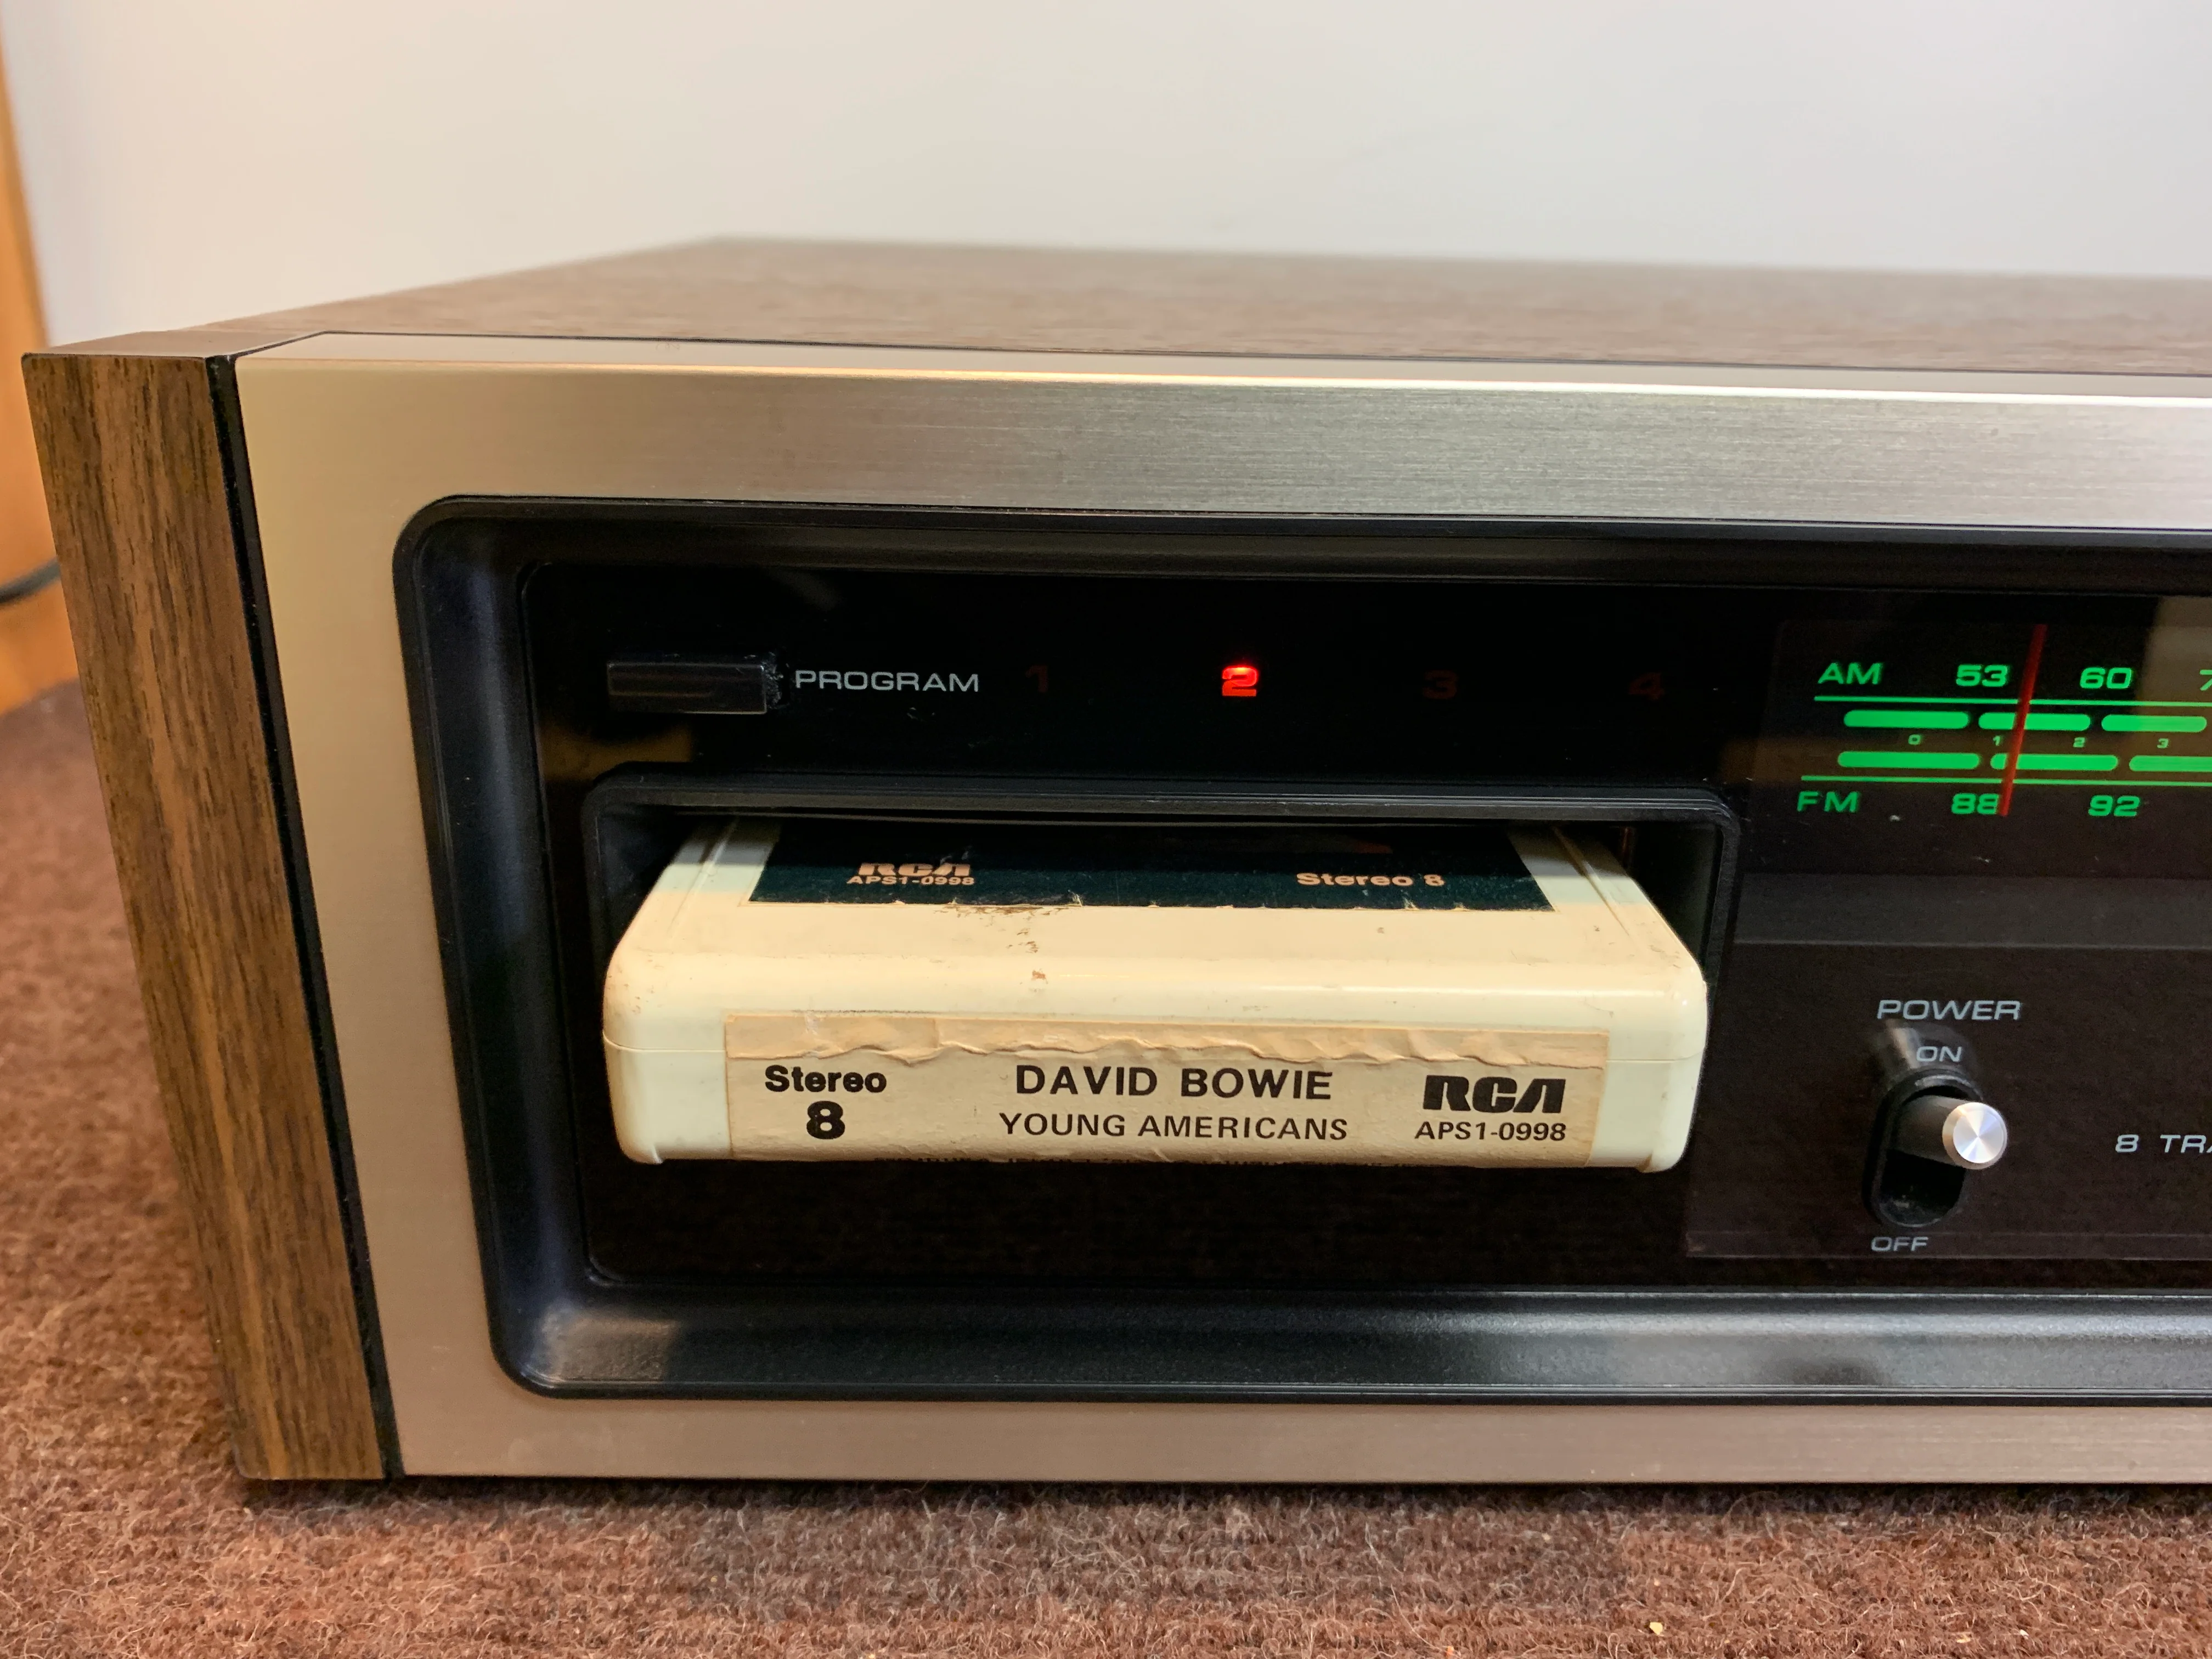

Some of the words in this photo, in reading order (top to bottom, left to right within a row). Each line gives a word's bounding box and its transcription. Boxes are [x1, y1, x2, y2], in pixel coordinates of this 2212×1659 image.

[795, 670, 980, 692] PROGRAM
[1025, 664, 1049, 693] 1
[1221, 664, 1259, 697] 2
[1422, 669, 1458, 700] 3
[1628, 672, 1665, 701] 4
[1818, 662, 1882, 685] AM
[1955, 665, 2008, 687] 53
[2079, 667, 2133, 689] 60
[1993, 735, 2001, 746] 1
[2072, 737, 2086, 748] 2
[2157, 738, 2169, 749] 3
[1797, 791, 1859, 812] FM
[1951, 793, 2000, 815] 88
[2088, 795, 2141, 817] 92
[859, 862, 971, 876] RCA
[1296, 872, 1413, 886] Stereo
[1424, 874, 1445, 886] 8
[847, 876, 975, 885] APS1-0998
[1877, 999, 2023, 1021] POWER
[1916, 1046, 1963, 1063] ON
[765, 1065, 887, 1093] Stereo
[1016, 1065, 1158, 1096] DAVID
[1181, 1068, 1333, 1100] BOWIE
[1423, 1074, 1566, 1114] RCA
[806, 1101, 845, 1140] 8
[999, 1112, 1126, 1137] YOUNG
[1138, 1115, 1348, 1140] AMERICANS
[1415, 1121, 1566, 1142] APS1-0998
[2115, 1134, 2138, 1152] 8
[2160, 1134, 2212, 1153] TR
[1871, 1237, 1928, 1252] OFF
